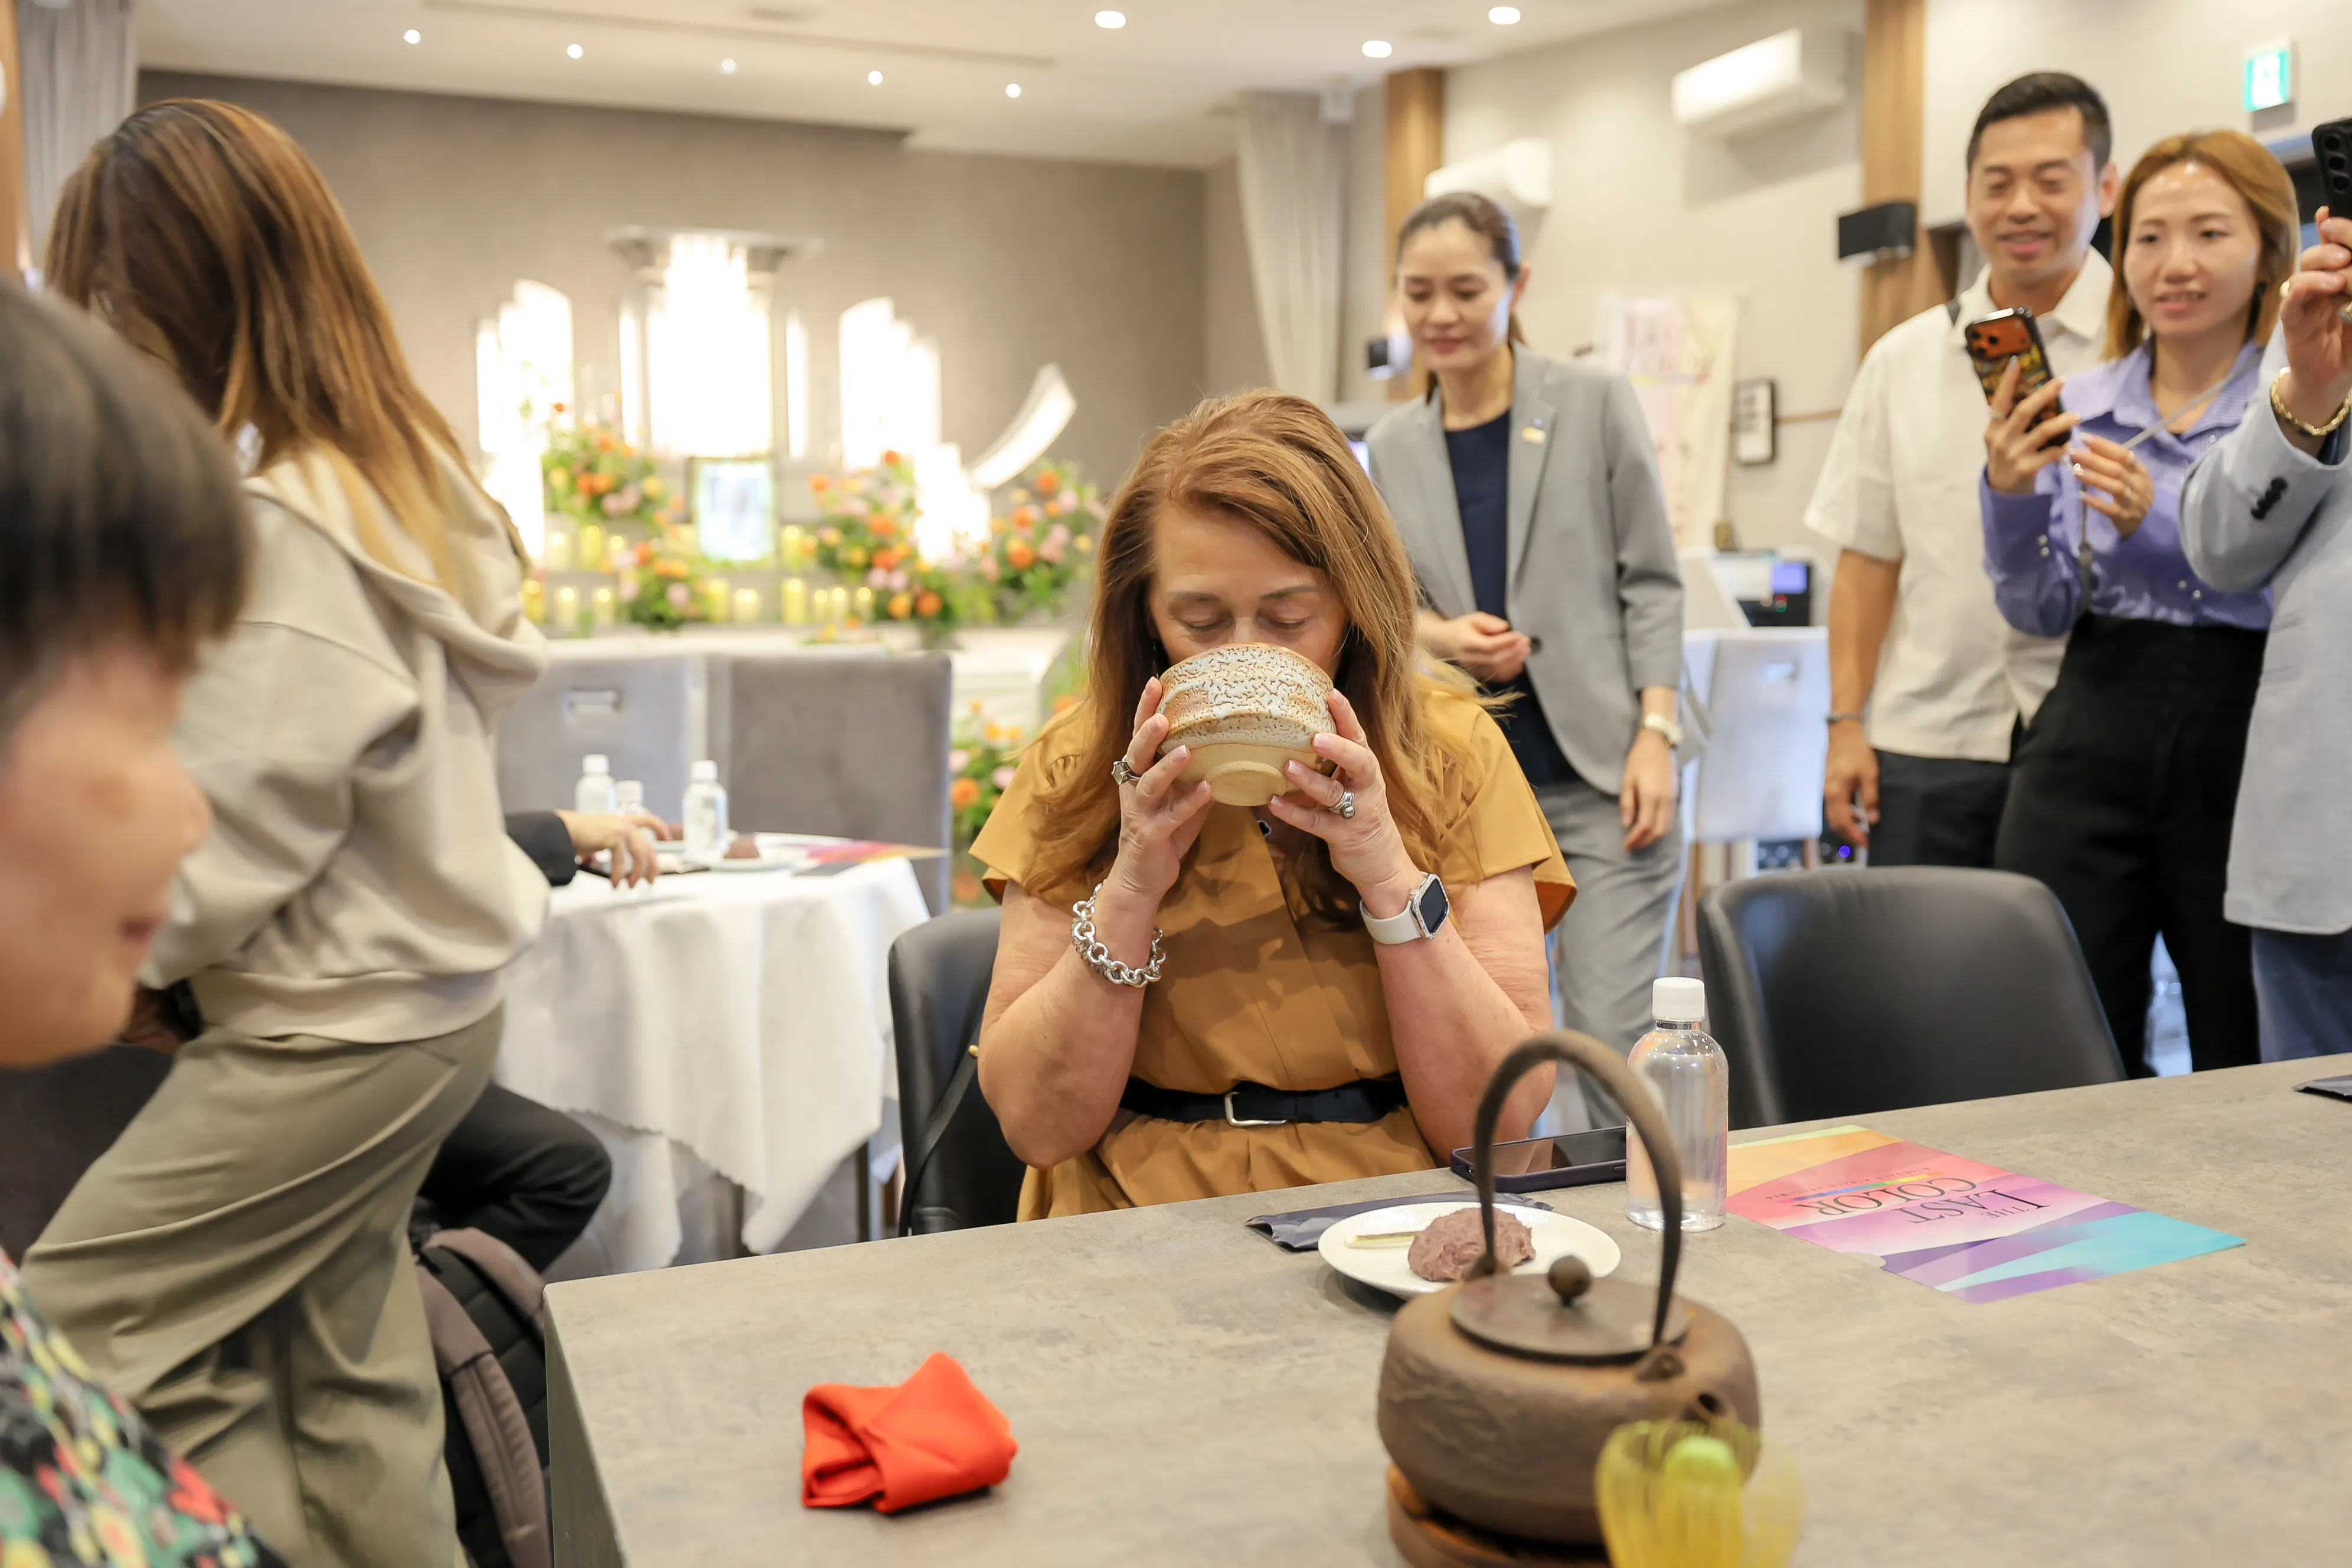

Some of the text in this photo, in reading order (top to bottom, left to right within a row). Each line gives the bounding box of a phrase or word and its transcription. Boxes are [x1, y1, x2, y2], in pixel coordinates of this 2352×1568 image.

[1791, 1178, 1977, 1215] COLOR
[1890, 1189, 2050, 1223] LAST
[1981, 1207, 2030, 1218] THE
